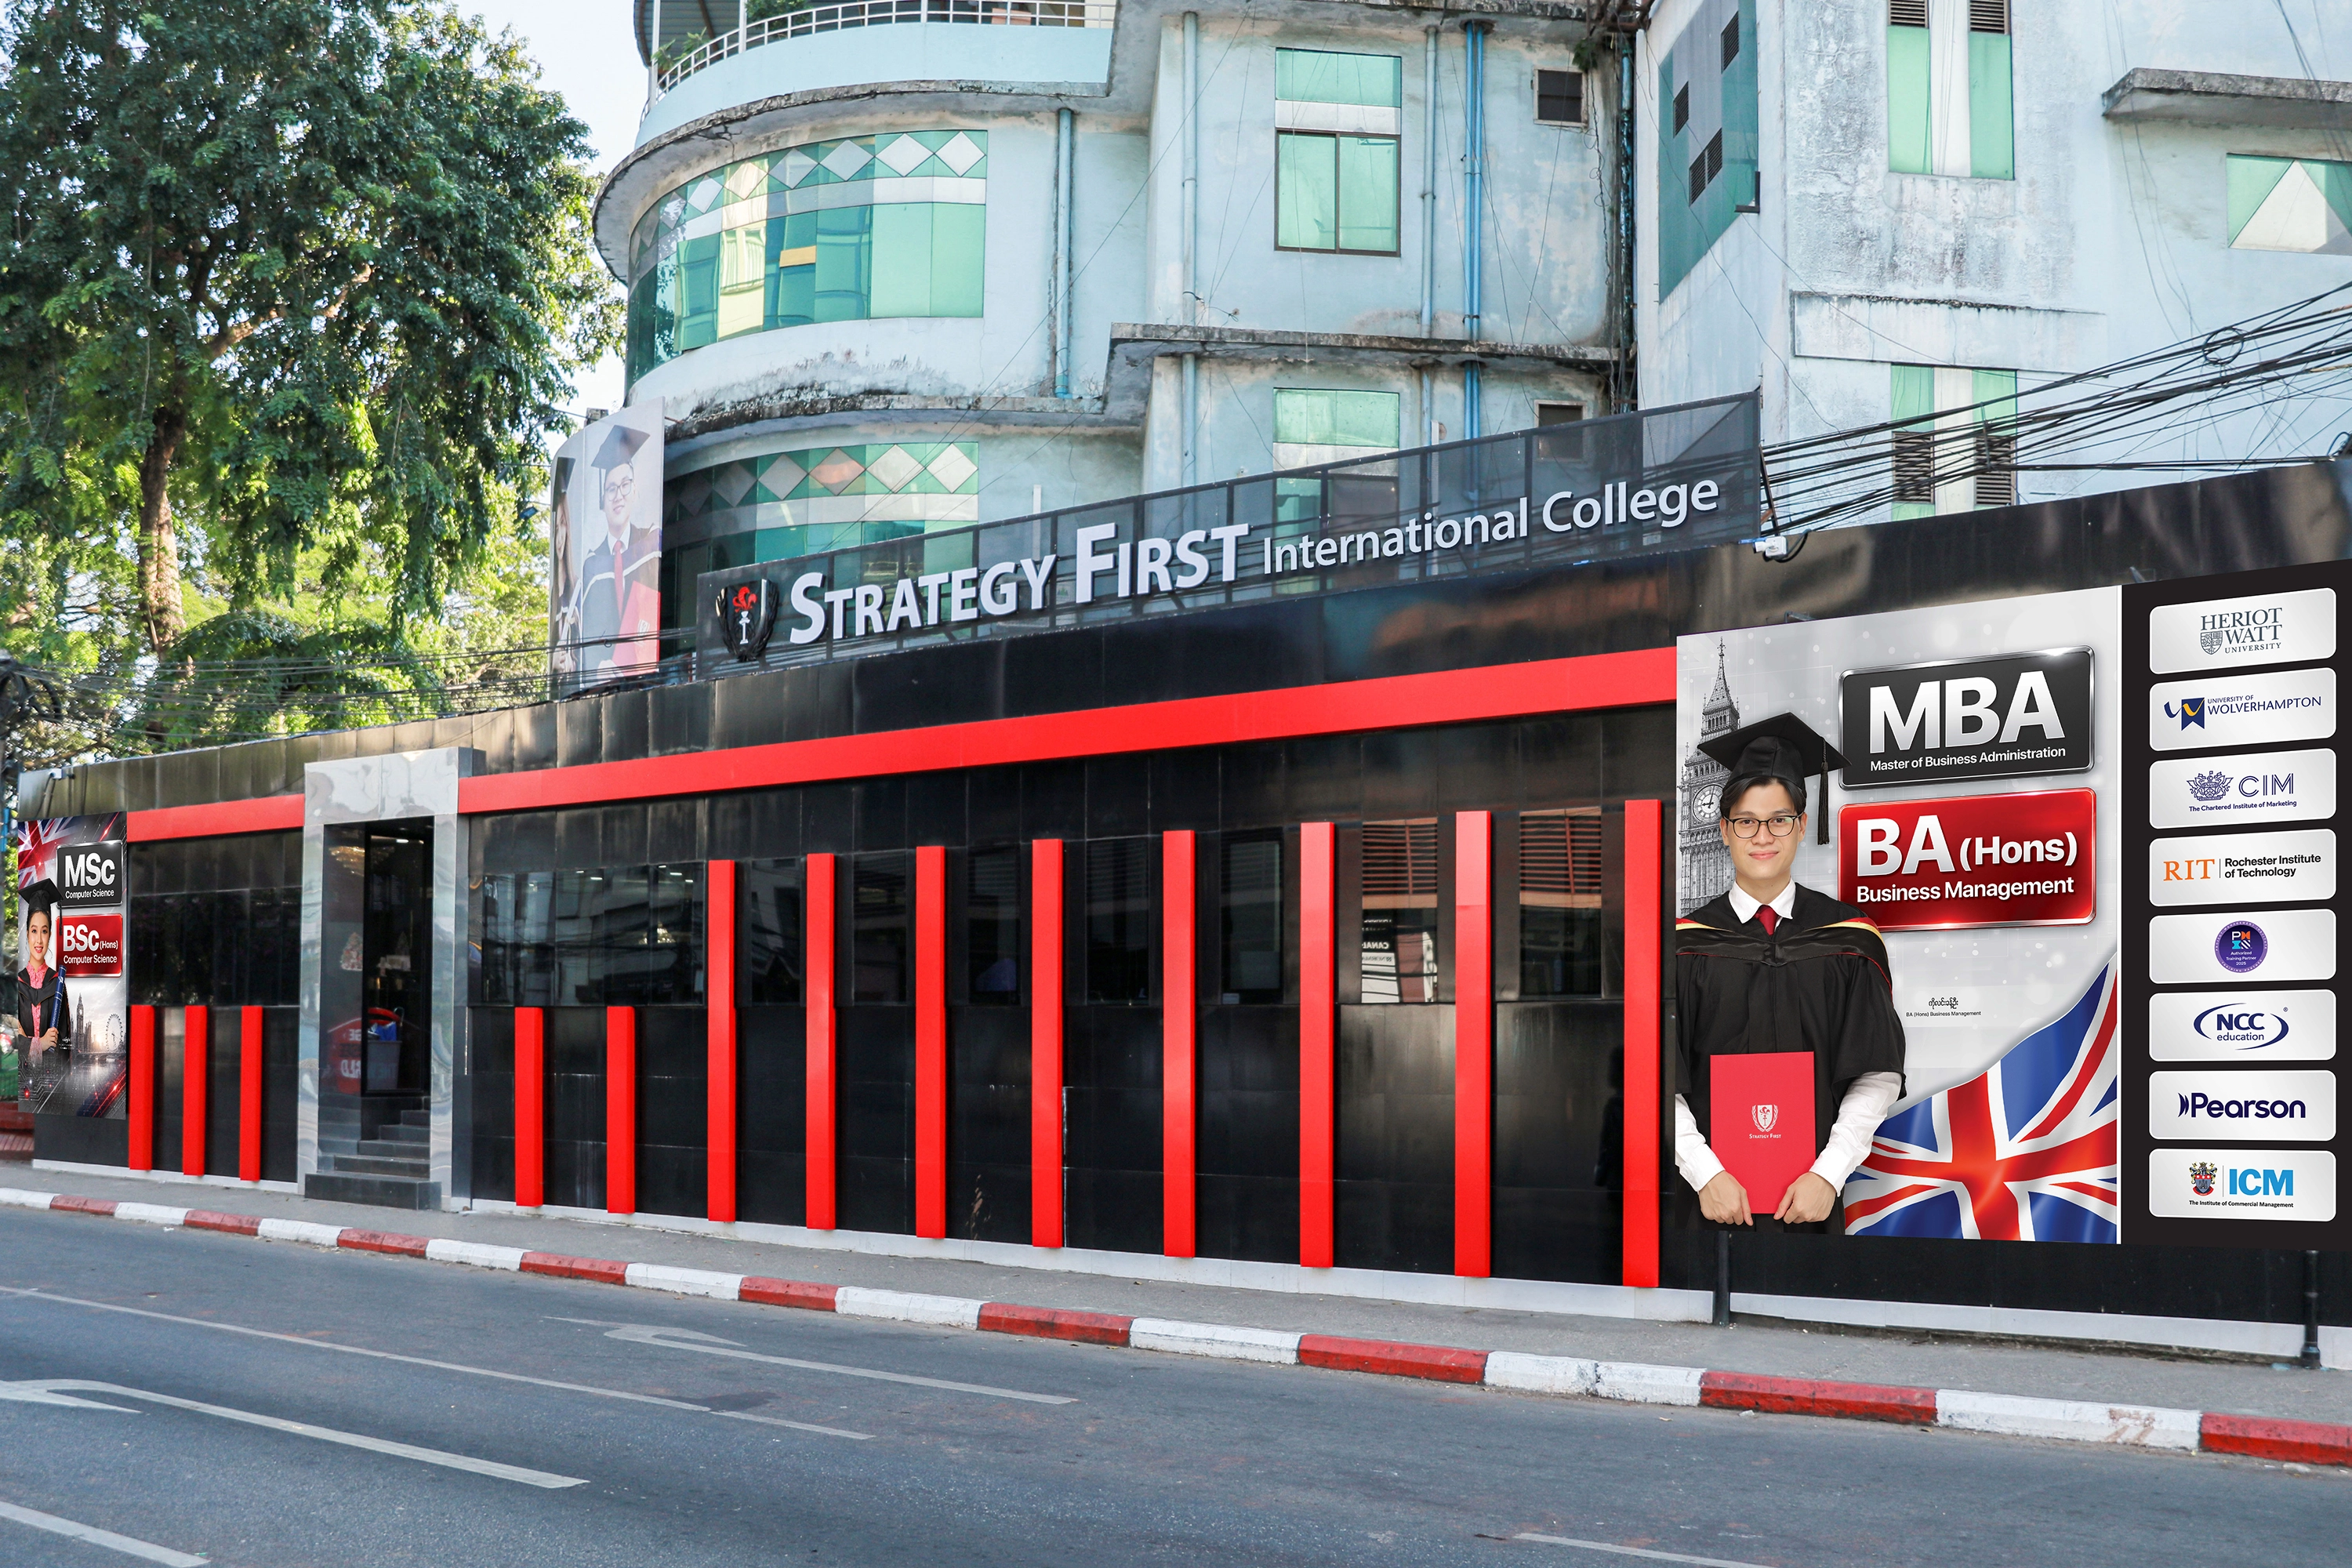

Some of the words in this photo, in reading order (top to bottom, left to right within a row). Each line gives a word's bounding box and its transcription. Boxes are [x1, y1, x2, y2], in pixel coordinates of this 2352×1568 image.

[789, 554, 1058, 644] STRATEGY
[1075, 522, 1250, 604] FIRST
[1263, 495, 1528, 575] International
[1543, 479, 1720, 529] College
[2201, 608, 2283, 631] HERIOT
[2224, 624, 2283, 644] WATT
[2225, 642, 2281, 654] UNIVERSITY
[2207, 695, 2244, 704] UNIVERSITY
[2207, 695, 2321, 715] WOLVERHAMPTON
[1869, 670, 2066, 754] MBA
[1870, 760, 1910, 771] Master
[1911, 758, 1923, 768] of
[1925, 754, 1977, 767] Business
[1979, 746, 2066, 763] Administration
[2238, 773, 2294, 797] CIM
[1857, 815, 1955, 877] BA
[1959, 831, 2078, 872] (Hons)
[64, 852, 115, 887] MSc
[2163, 858, 2216, 881] RIT
[2224, 868, 2235, 878] of
[2237, 866, 2296, 878] Technology
[2225, 856, 2277, 867] Rochester
[2278, 854, 2321, 865] Institute
[65, 889, 92, 900] Computer
[93, 888, 114, 898] Science
[1857, 884, 1940, 902] Business
[1944, 877, 2074, 900] Management
[63, 924, 100, 952] BSc
[100, 940, 118, 950] (Hons)
[64, 955, 93, 966] Computer
[93, 954, 118, 964] Science
[2216, 1012, 2265, 1031] NCC
[2216, 1032, 2264, 1041] education
[2190, 1092, 2306, 1119] Pearson
[2229, 1168, 2293, 1196] ICM
